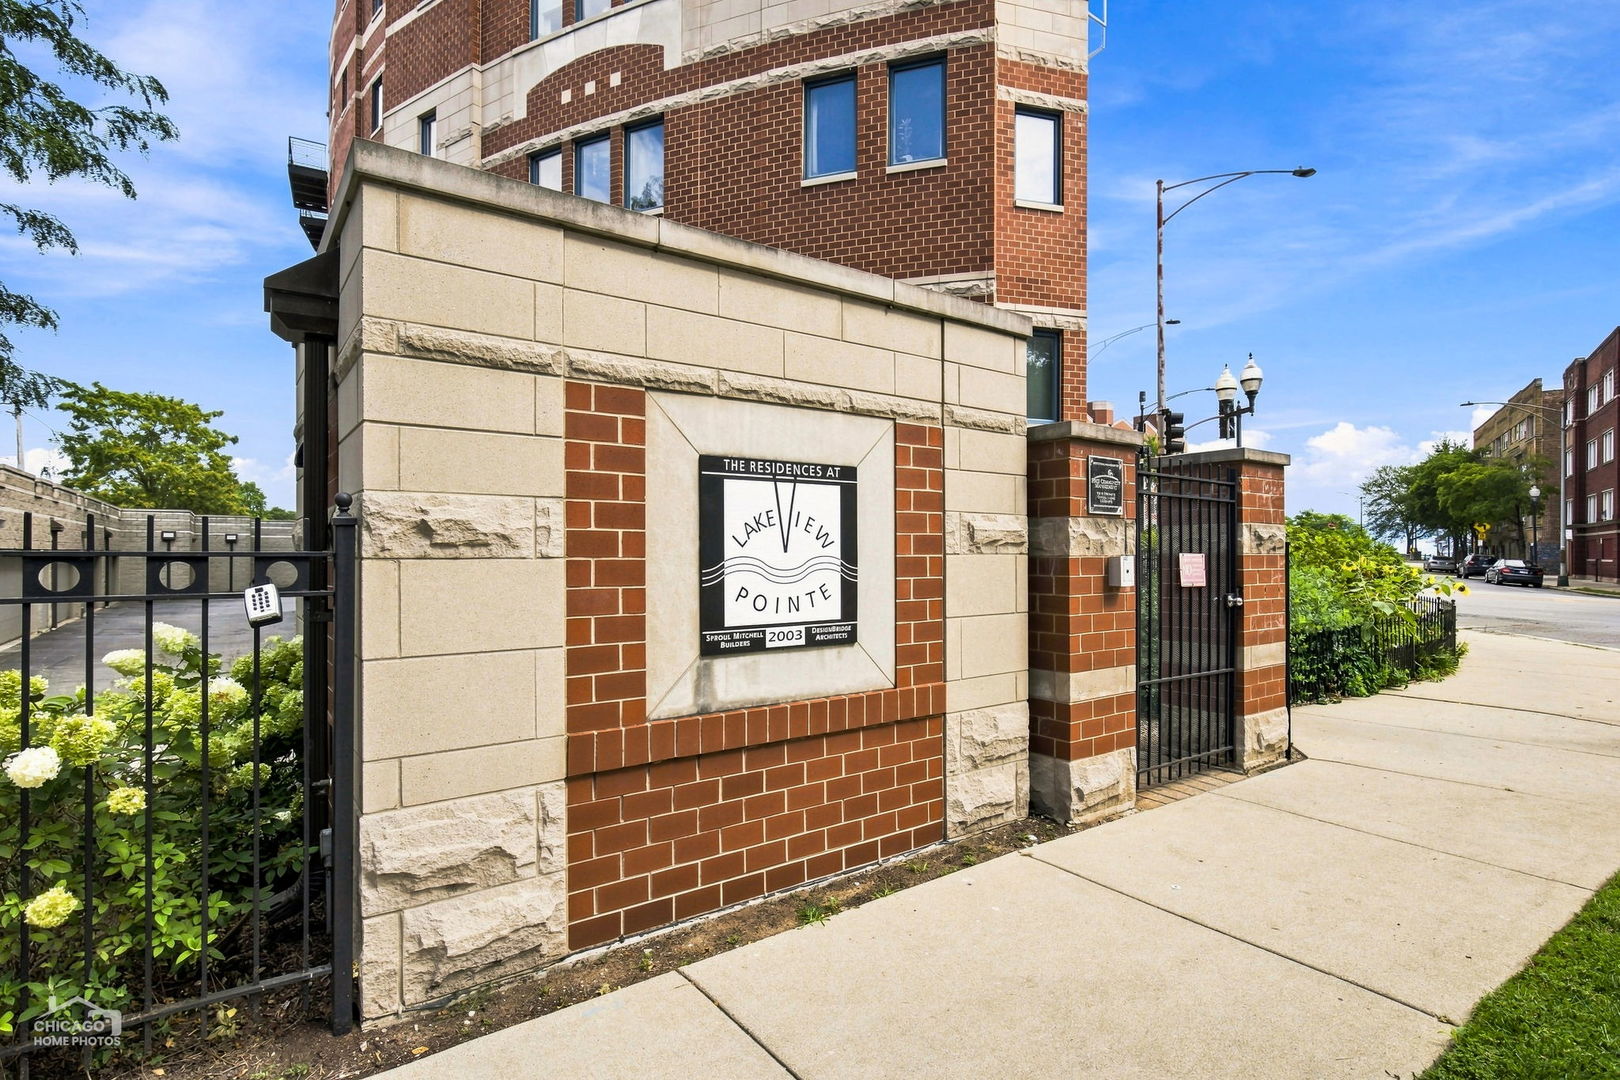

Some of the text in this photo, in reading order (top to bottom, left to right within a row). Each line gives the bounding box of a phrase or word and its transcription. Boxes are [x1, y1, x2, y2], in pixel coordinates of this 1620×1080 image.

[723, 459, 841, 478] THE RESIDENCES AT
[732, 509, 776, 548] LAKE
[735, 583, 832, 614] POINTE
[768, 630, 803, 643] 2003
